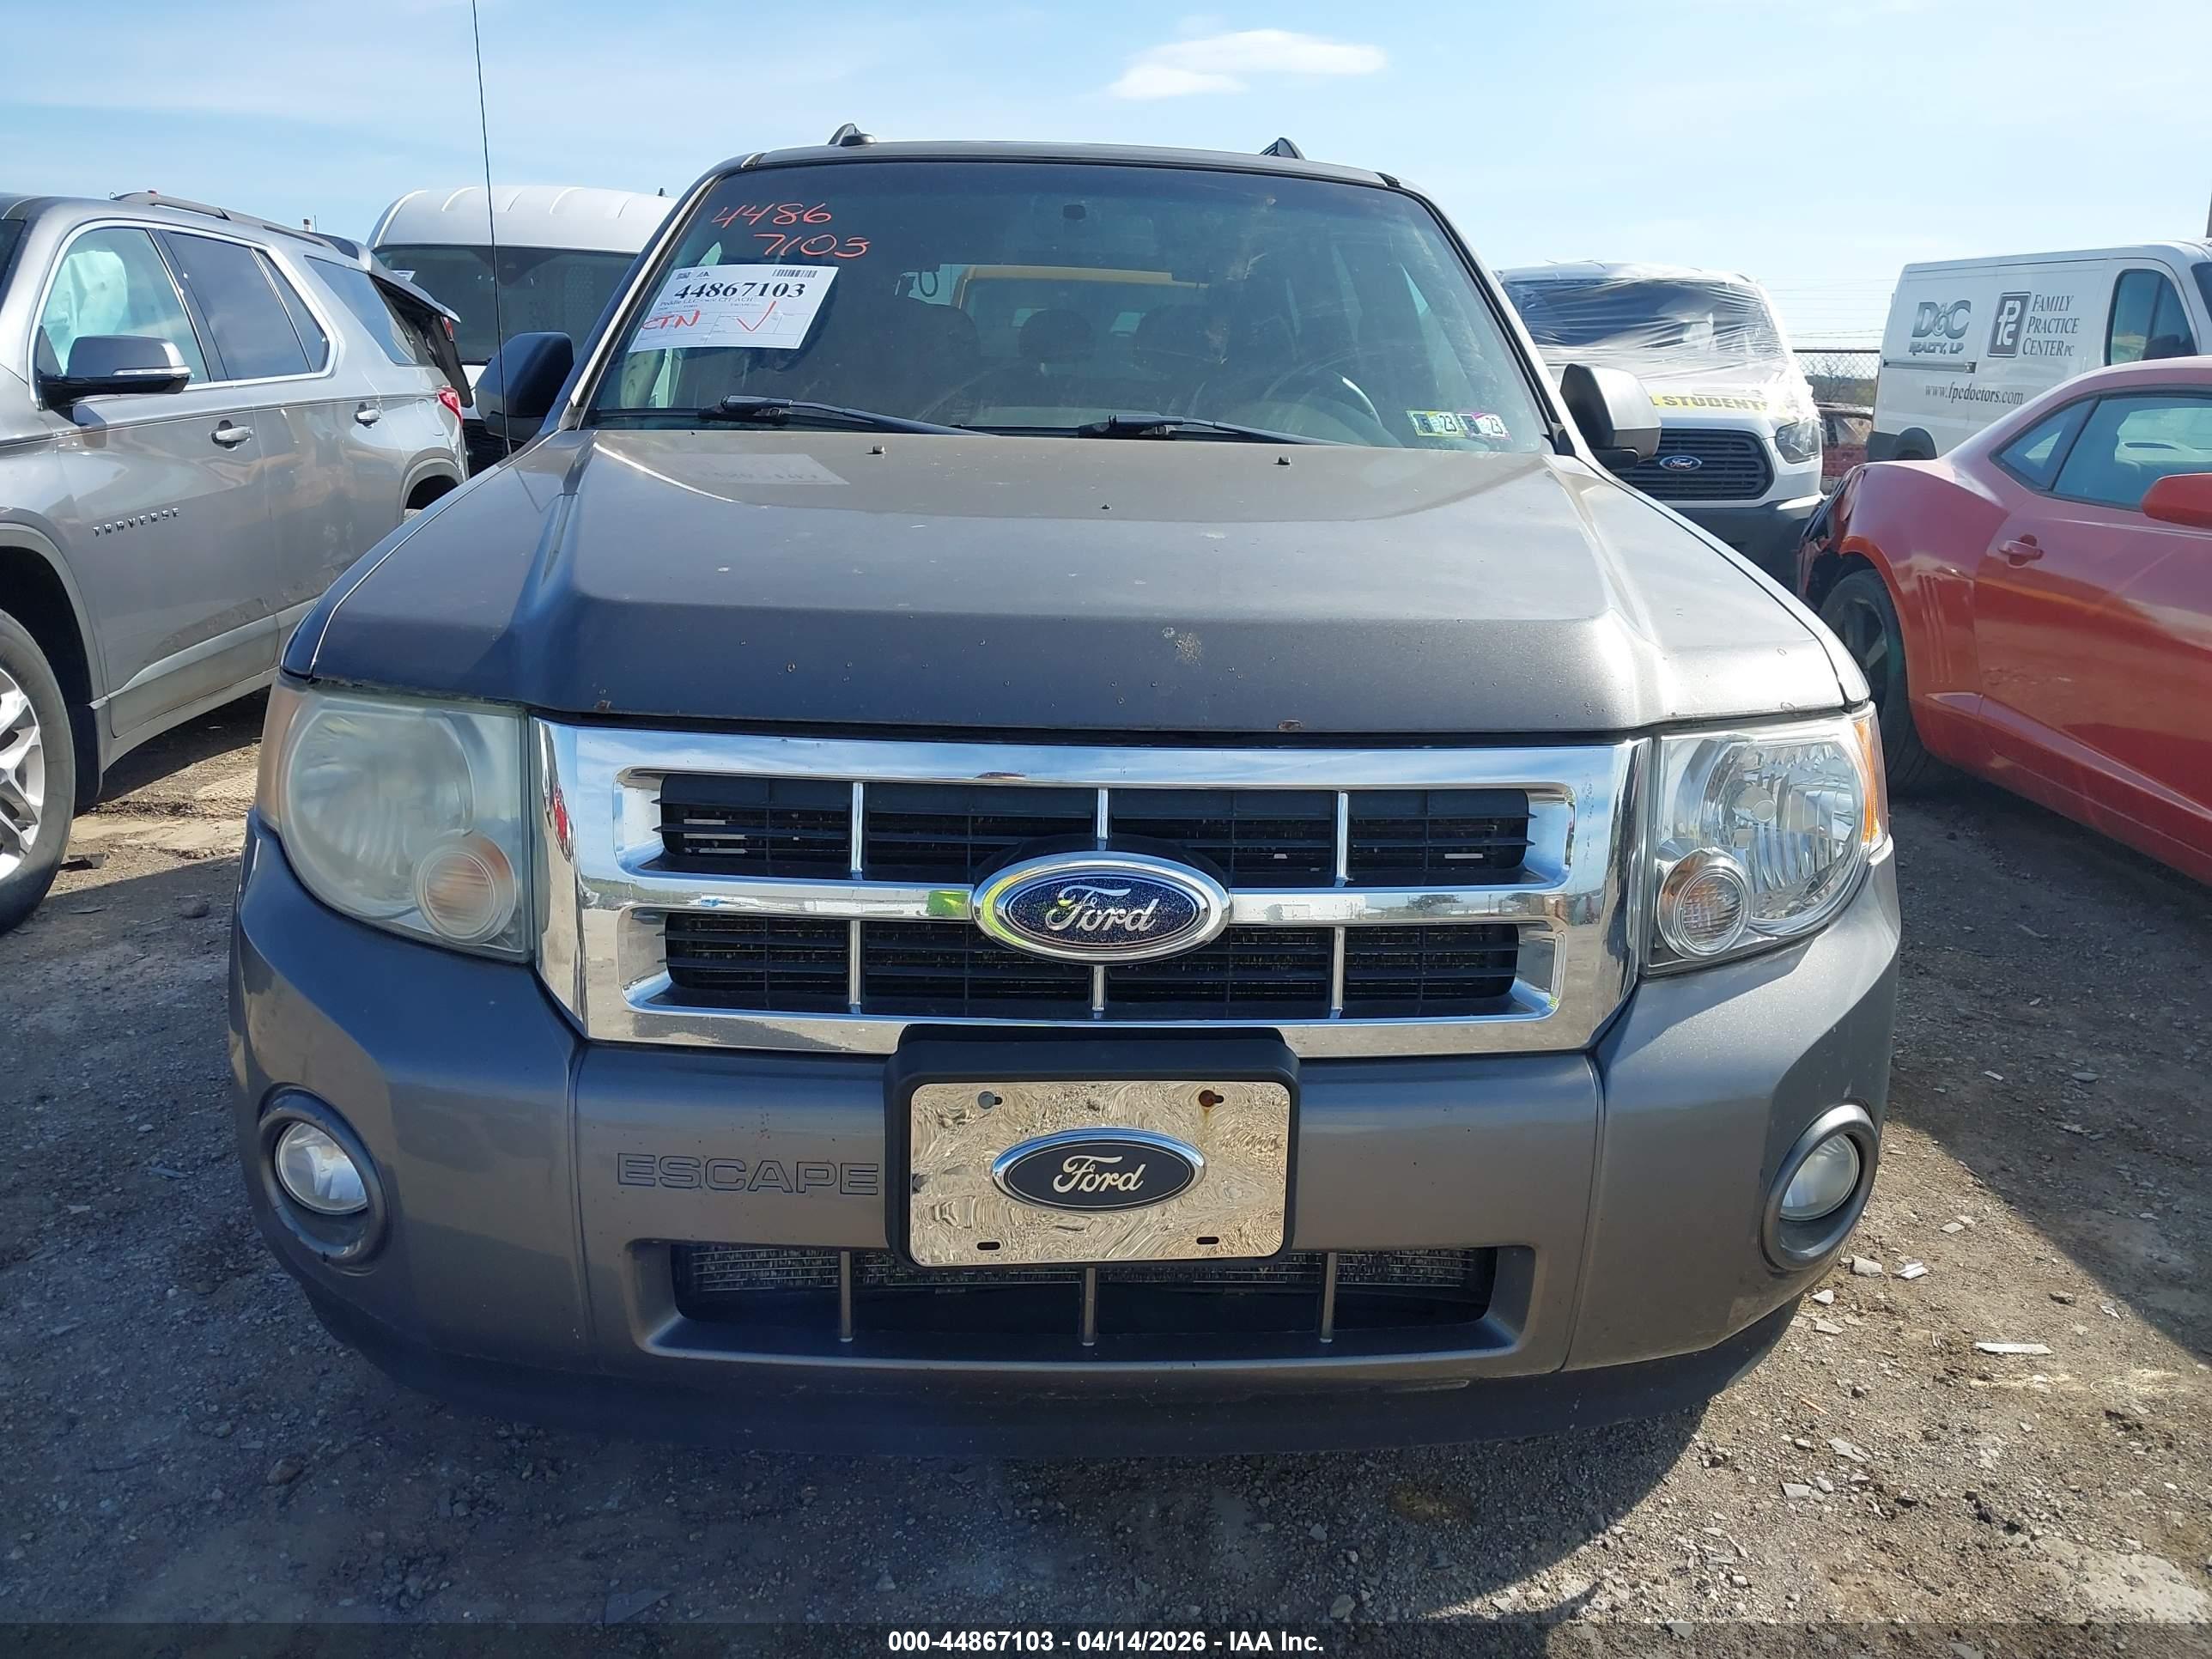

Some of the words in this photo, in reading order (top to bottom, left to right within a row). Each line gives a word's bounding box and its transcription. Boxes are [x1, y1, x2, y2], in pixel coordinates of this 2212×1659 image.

[712, 203, 833, 228] 4486
[753, 234, 871, 258] 7103
[674, 282, 805, 298] 44867103
[2031, 295, 2074, 312] FAMILY
[2027, 316, 2080, 334] PRACTICE
[2022, 337, 2063, 356] CENTER
[1925, 381, 2024, 405] www.fpcdoctors.com
[1439, 415, 1457, 432] 23
[1486, 417, 1503, 434] 23
[93, 507, 179, 538] TRAVERSE
[1045, 884, 1158, 932] Ford
[617, 1152, 878, 1195] ESCAPE
[1053, 1155, 1146, 1194] Ford
